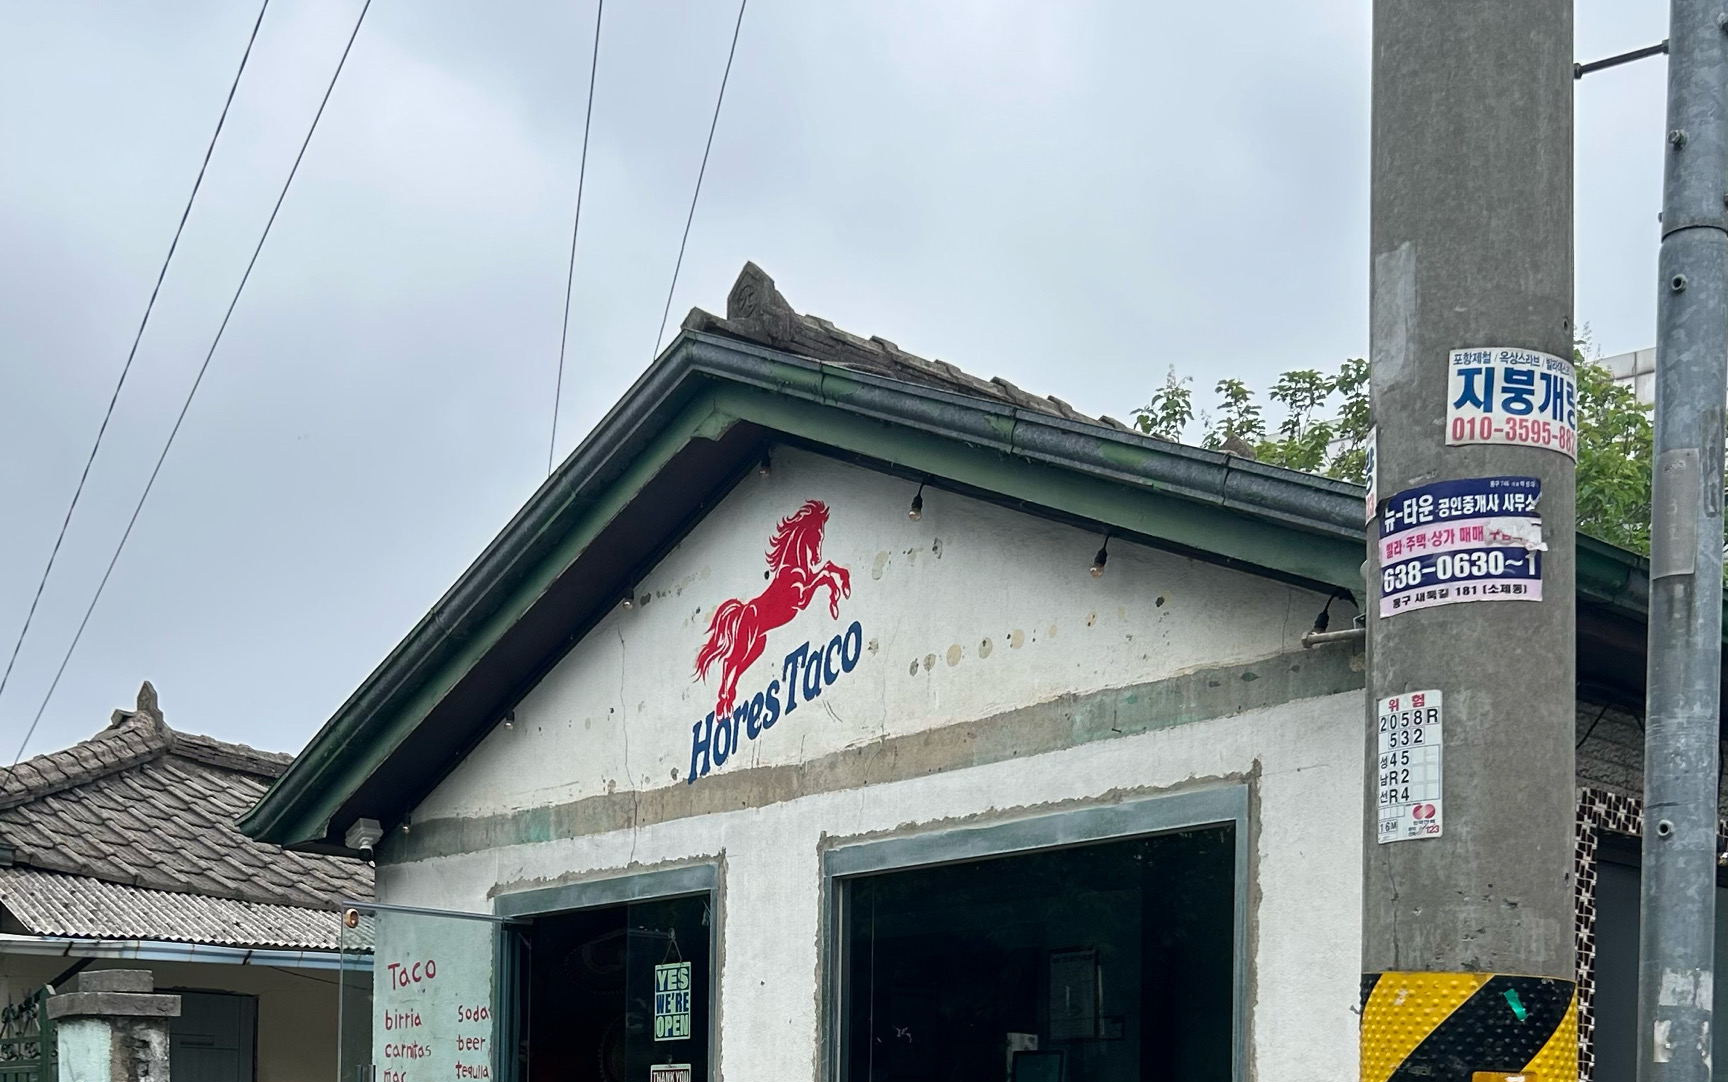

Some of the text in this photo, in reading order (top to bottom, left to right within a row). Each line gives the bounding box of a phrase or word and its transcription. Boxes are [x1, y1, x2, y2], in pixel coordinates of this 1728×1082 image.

[1452, 351, 1492, 366] 포항제철
[1384, 494, 1434, 533] 뉴-타운
[1438, 493, 1500, 518] 공인중개사
[1502, 493, 1537, 512] 사무소
[1459, 525, 1485, 543] 매매
[1455, 585, 1478, 597] 181
[688, 621, 862, 785] Hores Taco
[1389, 729, 1423, 748] 532
[387, 959, 437, 991] Taco
[655, 967, 690, 992] YES
[655, 991, 690, 1015] WE'RE
[385, 1008, 422, 1031] birria
[655, 1014, 690, 1038] OPEN
[384, 1034, 486, 1060] carnitas beer
[455, 1060, 490, 1080] tequila
